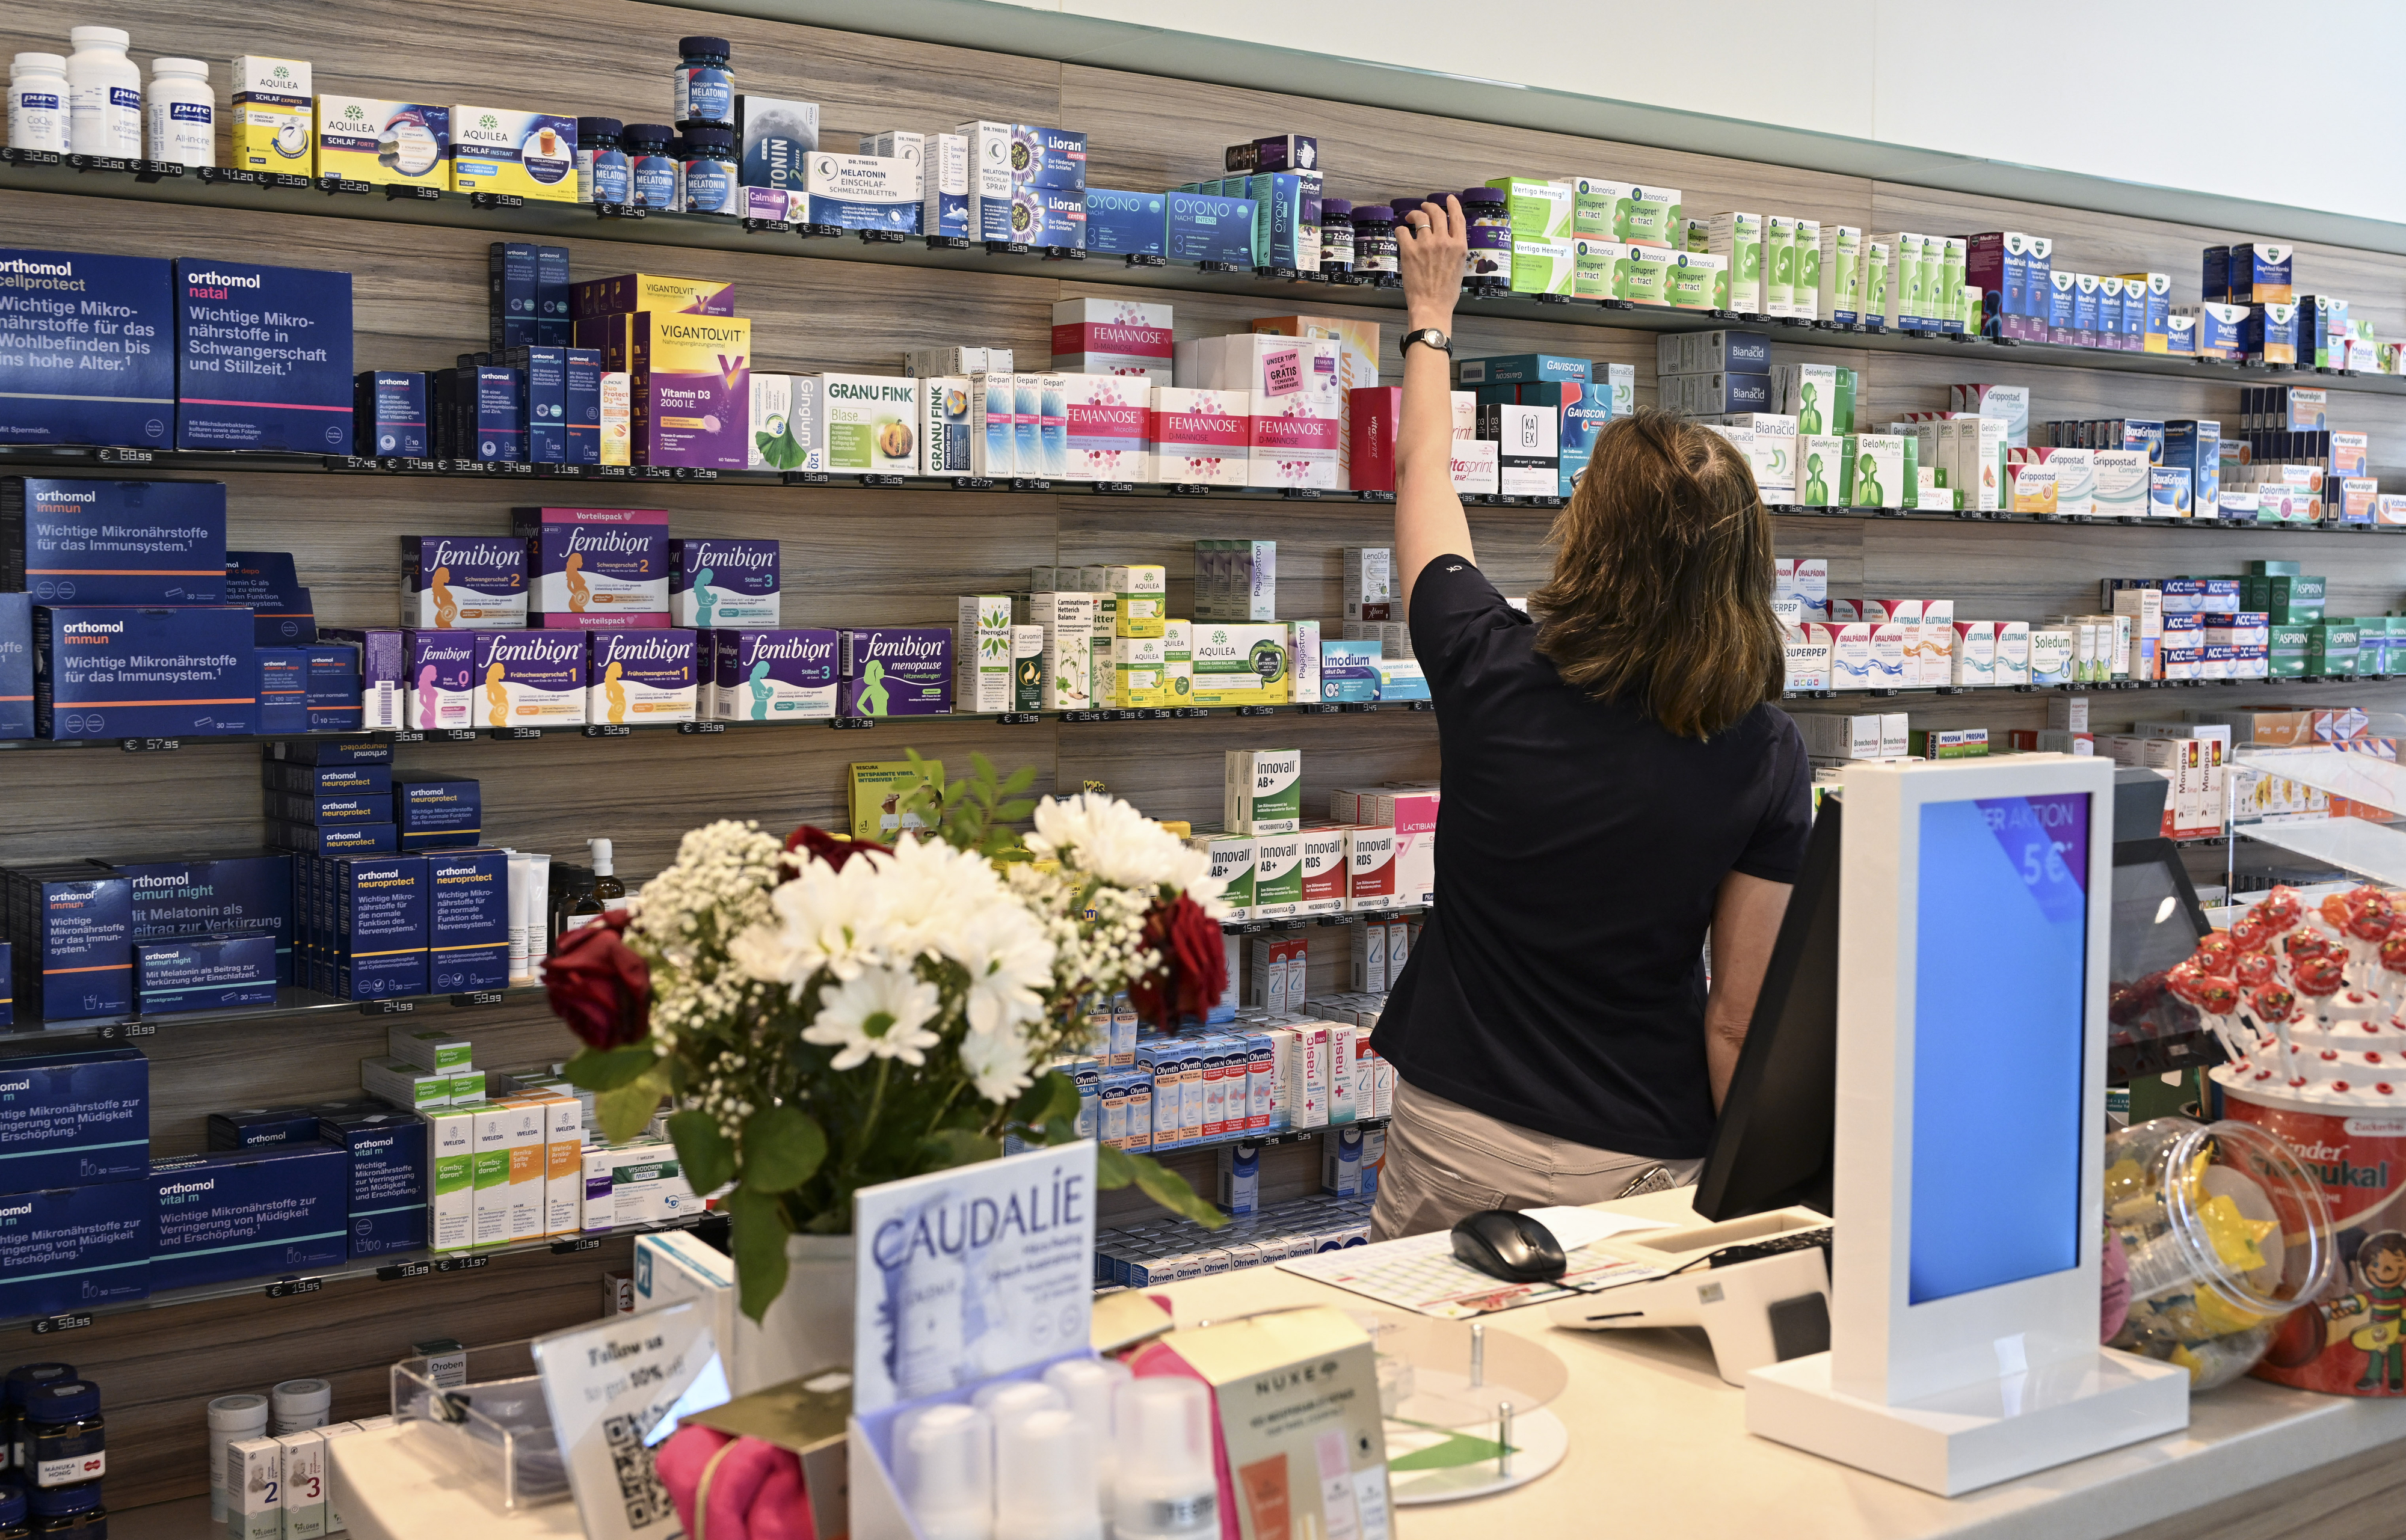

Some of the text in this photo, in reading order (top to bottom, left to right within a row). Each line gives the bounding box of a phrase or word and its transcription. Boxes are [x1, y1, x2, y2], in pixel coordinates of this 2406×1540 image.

[260, 79, 298, 90] AQUILEA
[692, 81, 713, 89] Hoggar
[256, 94, 280, 102] SCHLAF
[692, 88, 727, 97] MELATONIN
[24, 94, 56, 103] pure
[175, 105, 209, 115] pure
[328, 121, 375, 132] AQUILEA
[176, 134, 209, 146] All-in-one
[328, 137, 355, 146] SCHLAF
[464, 130, 508, 142] AQUILEA
[1048, 136, 1081, 152] Lioran
[2, 149, 57, 162] € 32.60
[463, 146, 489, 155] SCHLAF
[72, 155, 125, 169] € 35.60
[131, 159, 182, 173] € 30.70
[841, 168, 886, 179] MELATONIN
[841, 178, 885, 188] EINSCHLAF-
[986, 182, 1007, 191] SPRAY
[829, 186, 897, 197] SCHMELZTABLETTEN
[1513, 185, 1537, 195] Vertigo
[750, 192, 785, 204] Calmalaif
[1643, 191, 1668, 202] Bionorica
[1175, 198, 1229, 217] OYONO
[1631, 205, 1657, 216] Sinupret
[1175, 214, 1216, 224] NACHT INTENS
[1630, 216, 1652, 225] extract
[2005, 257, 2026, 267] MediNait
[188, 271, 260, 288] orthomol
[189, 286, 227, 299] natal
[81, 301, 137, 318] Mikro-
[189, 307, 314, 327] Wichtige Mikro-
[94, 321, 118, 334] für
[124, 322, 155, 336] das
[189, 324, 288, 342] nährstoffe in
[661, 325, 740, 342] VIGANTOLVIT
[2217, 324, 2238, 336] DayNait
[125, 340, 150, 354] bis
[662, 338, 725, 349] Nahrungsergänzungsmittel
[189, 340, 327, 361] Schwangerschaft
[2352, 348, 2373, 358] Mobilat
[30, 353, 73, 369] hohe
[1267, 353, 1296, 366] UNSER TIPP
[189, 359, 219, 372] und
[1271, 366, 1296, 380] GRATIS
[1275, 377, 1295, 385] FEMAVIVA
[661, 388, 710, 399] Vitamin D3
[829, 383, 913, 402] GRANU FINK
[1272, 384, 1299, 392] TRINKBRAUSE
[1989, 391, 2020, 402] Grippostad
[661, 398, 696, 408] 2000 I.E.
[802, 379, 813, 447] Gingium
[831, 408, 858, 421] Blase
[1568, 407, 1605, 420] GAVISCON
[1169, 417, 1237, 432] FEMANNOSE
[1755, 422, 1795, 437] Bianacid
[1169, 432, 1208, 442] D-MANNOSE
[2339, 436, 2362, 445] Neuralgin
[1862, 439, 1901, 450] GeloMyrtol
[100, 449, 152, 461] € 68.99
[2153, 473, 2189, 485] BoxaGrippal
[37, 491, 96, 503] orthomol
[37, 503, 81, 513] immun
[577, 512, 622, 521] Vorteilspack
[37, 524, 208, 539] Wichtige Mikronährstoffe
[37, 539, 58, 550] für
[61, 539, 86, 551] das
[559, 527, 649, 557] femibion
[640, 560, 648, 572] 2
[1925, 616, 1952, 624] ELOTRANS
[2168, 618, 2183, 628] ACC
[1875, 634, 1902, 642] ORALPÄDON
[2035, 635, 2070, 649] Soledum
[2279, 633, 2307, 644] ASPIRIN
[478, 636, 578, 667] femibion
[1199, 647, 1236, 657] AQUILEA
[1786, 648, 1827, 657] SUPERPEP
[891, 660, 941, 672] menopause
[1325, 655, 1369, 666] Imodium
[511, 668, 577, 681] Frühschwangerschaft 1
[126, 738, 178, 749] € 57.95
[1942, 734, 1961, 743] PROSPAN
[1258, 761, 1295, 775] Innovall
[1257, 777, 1274, 788] AB+
[1259, 822, 1285, 830] MICROBIOTICA
[358, 869, 398, 879] orthomol
[358, 877, 414, 888] neuroprotect
[1243, 924, 1260, 933] 15.50
[146, 951, 179, 960] orthomol
[172, 957, 191, 966] night
[1306, 1036, 1315, 1079] nasic
[1157, 1065, 1179, 1075] Olynth
[440, 1164, 464, 1173] Combu-
[628, 1164, 663, 1174] VISIODORON
[159, 1179, 214, 1195] orthomol
[160, 1194, 199, 1206] vital m
[1149, 1272, 1174, 1284] Otriven
[1255, 1366, 1315, 1396] NUXE
[265, 1482, 277, 1503] 2
[307, 1477, 320, 1499] 3
